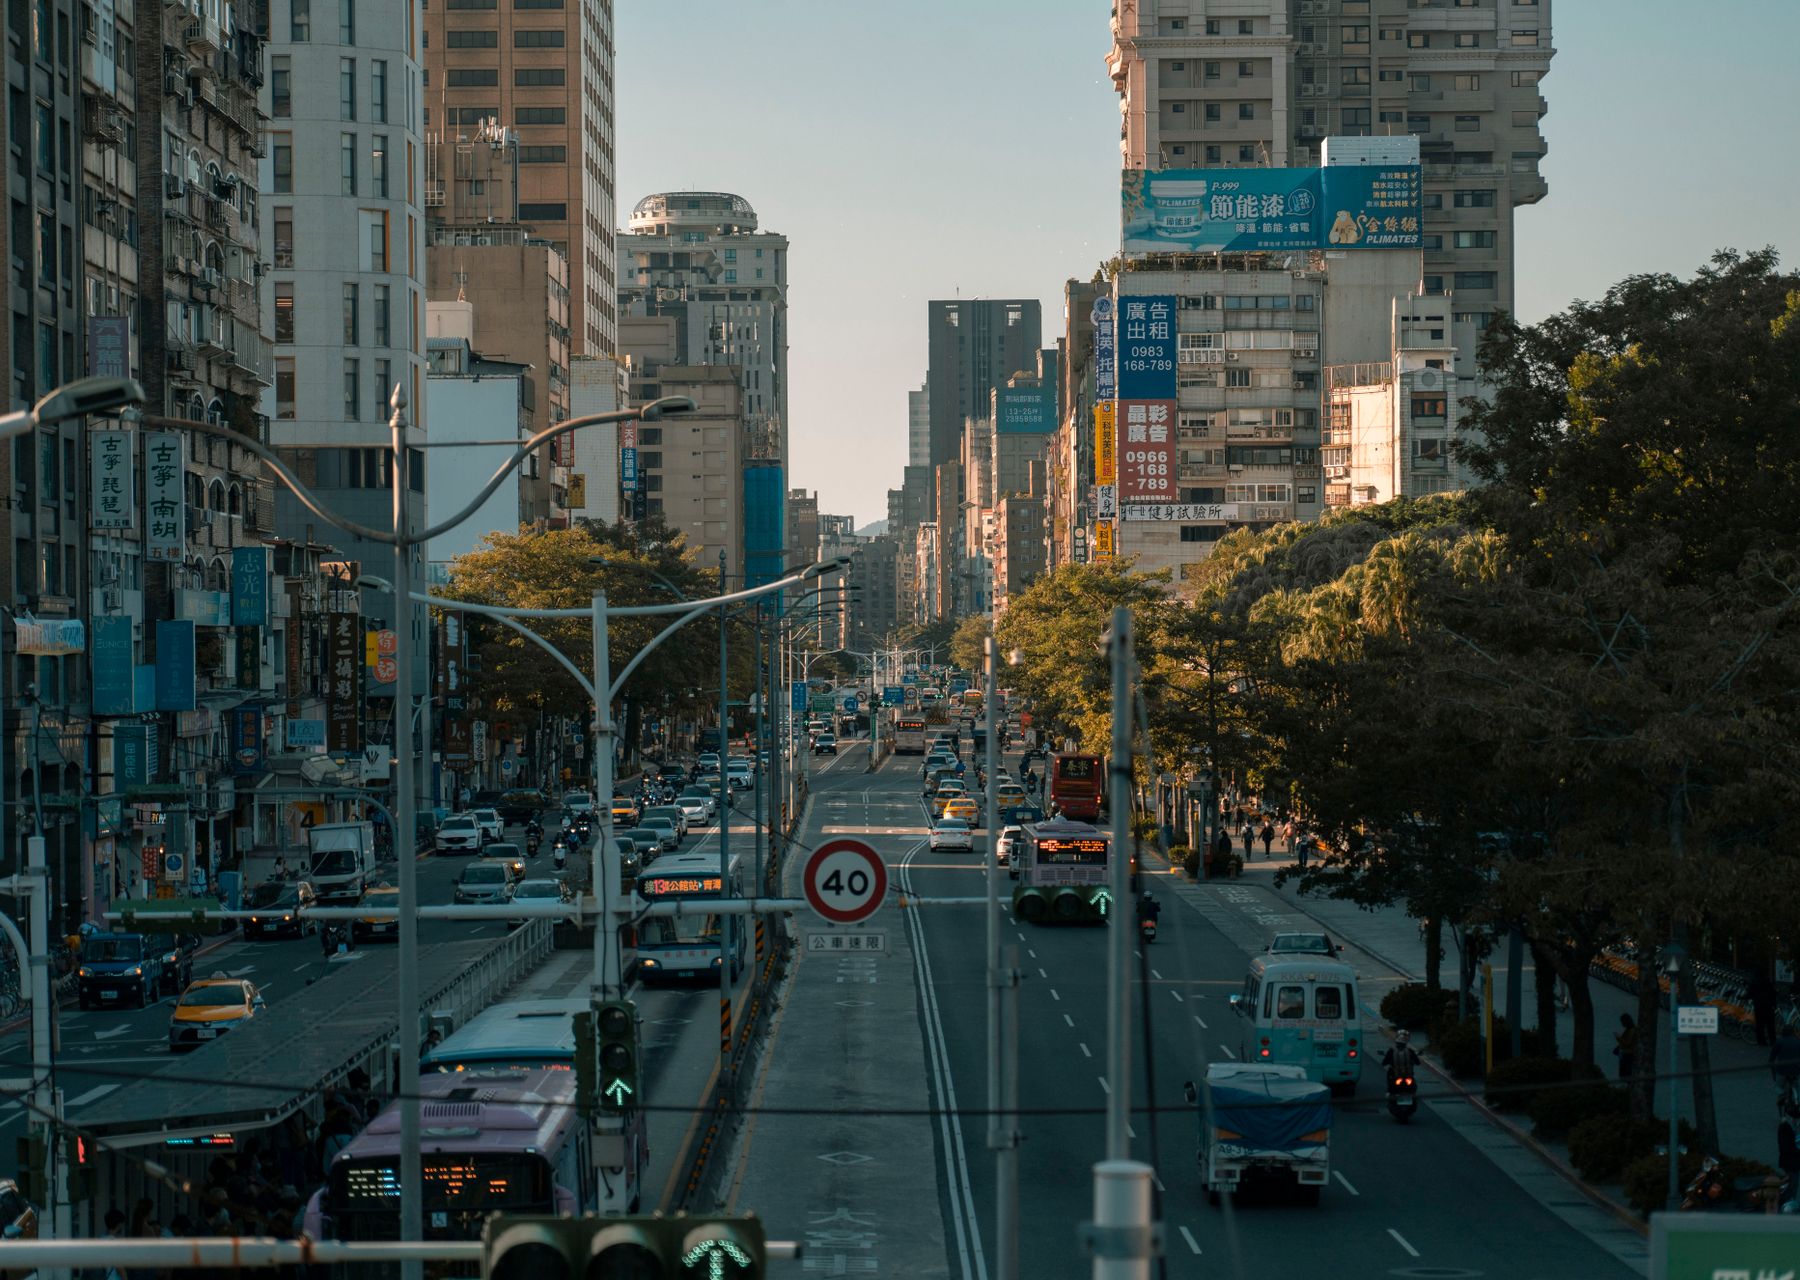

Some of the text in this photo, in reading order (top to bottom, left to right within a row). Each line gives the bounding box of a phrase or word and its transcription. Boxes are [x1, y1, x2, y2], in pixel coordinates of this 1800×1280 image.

[1211, 181, 1240, 191] P-999
[1161, 199, 1201, 207] PLIMATES
[1210, 194, 1284, 219] 節能漆
[1365, 216, 1418, 233] 金絲猴
[1366, 234, 1418, 244] PLIMATES
[1126, 302, 1170, 320] 廣告
[1127, 322, 1170, 340] 出租
[1131, 346, 1164, 357] 0983
[1124, 360, 1172, 371] 168-789
[1100, 388, 1114, 397] 4F
[1127, 425, 1168, 443] 廣告
[1126, 451, 1168, 463] 0966
[150, 442, 179, 539] 古箏·南胡
[1148, 505, 1222, 520] 健身試驗所
[239, 553, 261, 595] 志光
[821, 869, 869, 896] 40
